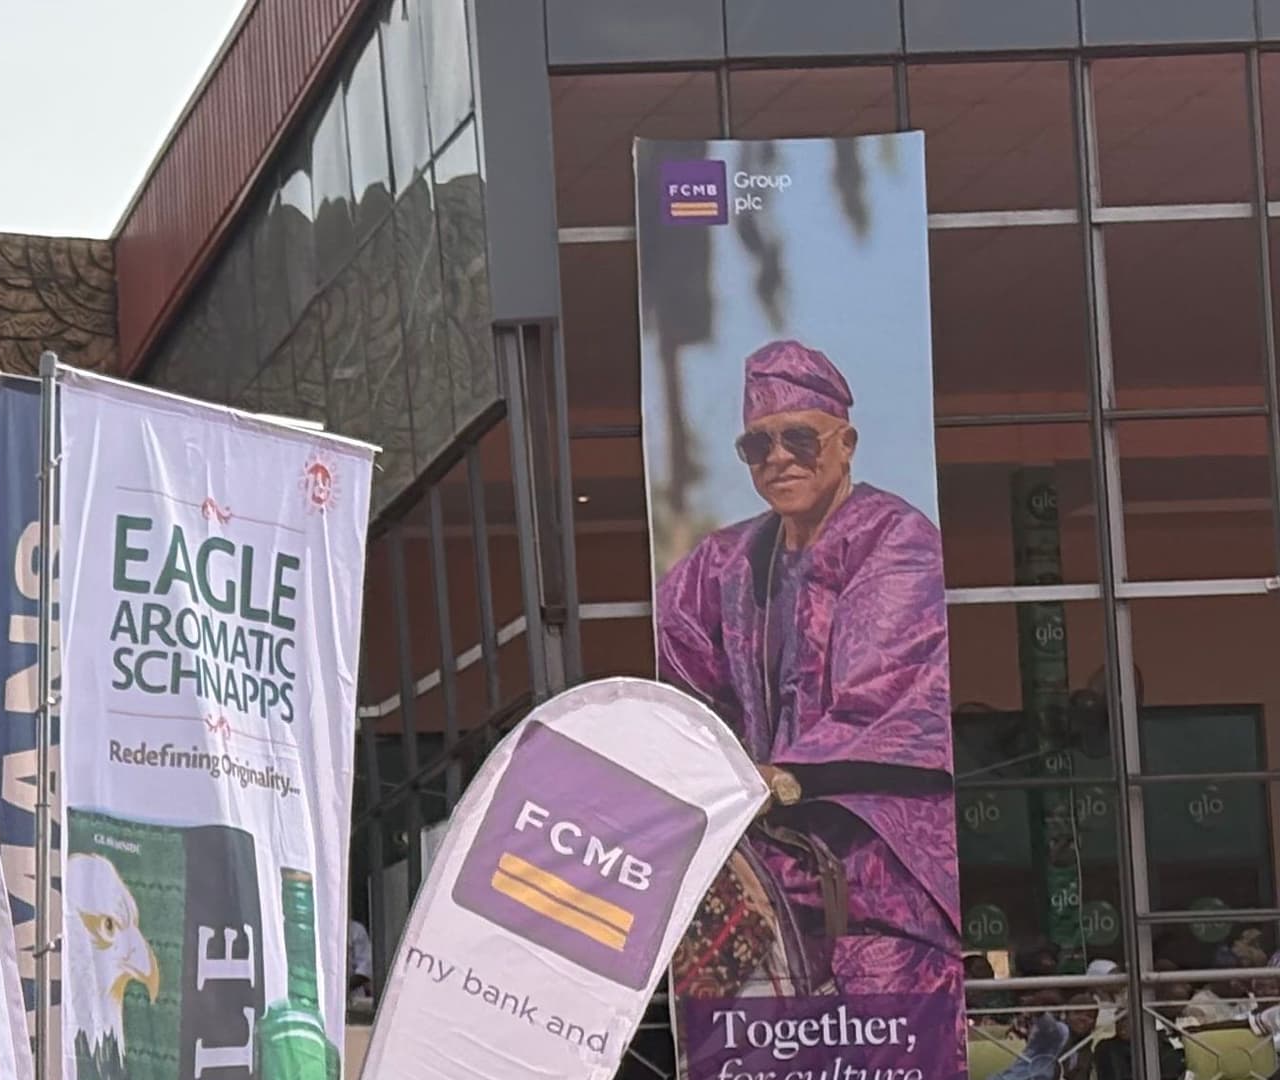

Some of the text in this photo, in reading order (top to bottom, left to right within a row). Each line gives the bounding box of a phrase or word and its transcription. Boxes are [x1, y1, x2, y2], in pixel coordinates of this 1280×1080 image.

[669, 183, 718, 197] FCMB
[733, 170, 793, 193] Group
[734, 193, 763, 215] plc
[112, 513, 301, 632] EAGLE
[109, 599, 297, 681] AROMATIC
[111, 646, 295, 725] SCHNAPPS
[109, 739, 221, 779] Redefining
[963, 800, 1000, 827] glo
[1188, 793, 1225, 823] glo
[513, 799, 654, 892] FCMB
[967, 914, 1004, 942] glo
[405, 944, 610, 1056] my bank and
[711, 1004, 917, 1060] Together,
